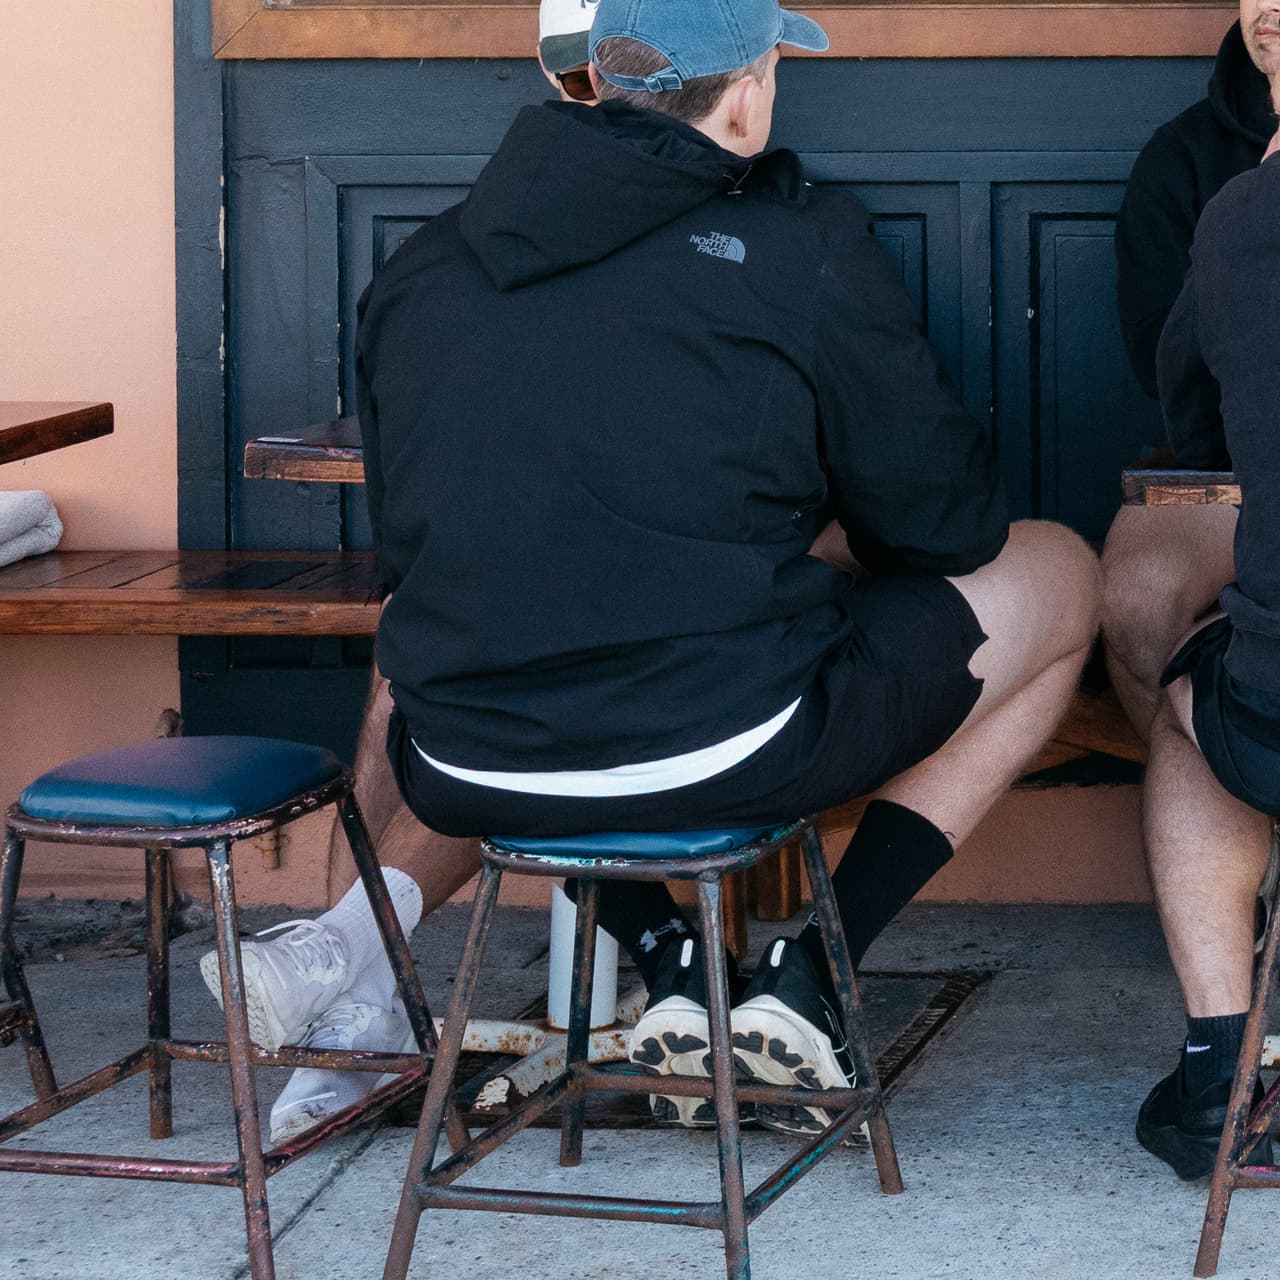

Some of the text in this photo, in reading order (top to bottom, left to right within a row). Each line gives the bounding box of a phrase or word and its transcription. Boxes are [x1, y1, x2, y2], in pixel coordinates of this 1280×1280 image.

[689, 234, 730, 250] NORTH
[710, 231, 731, 242] THE
[696, 244, 726, 258] FACE
